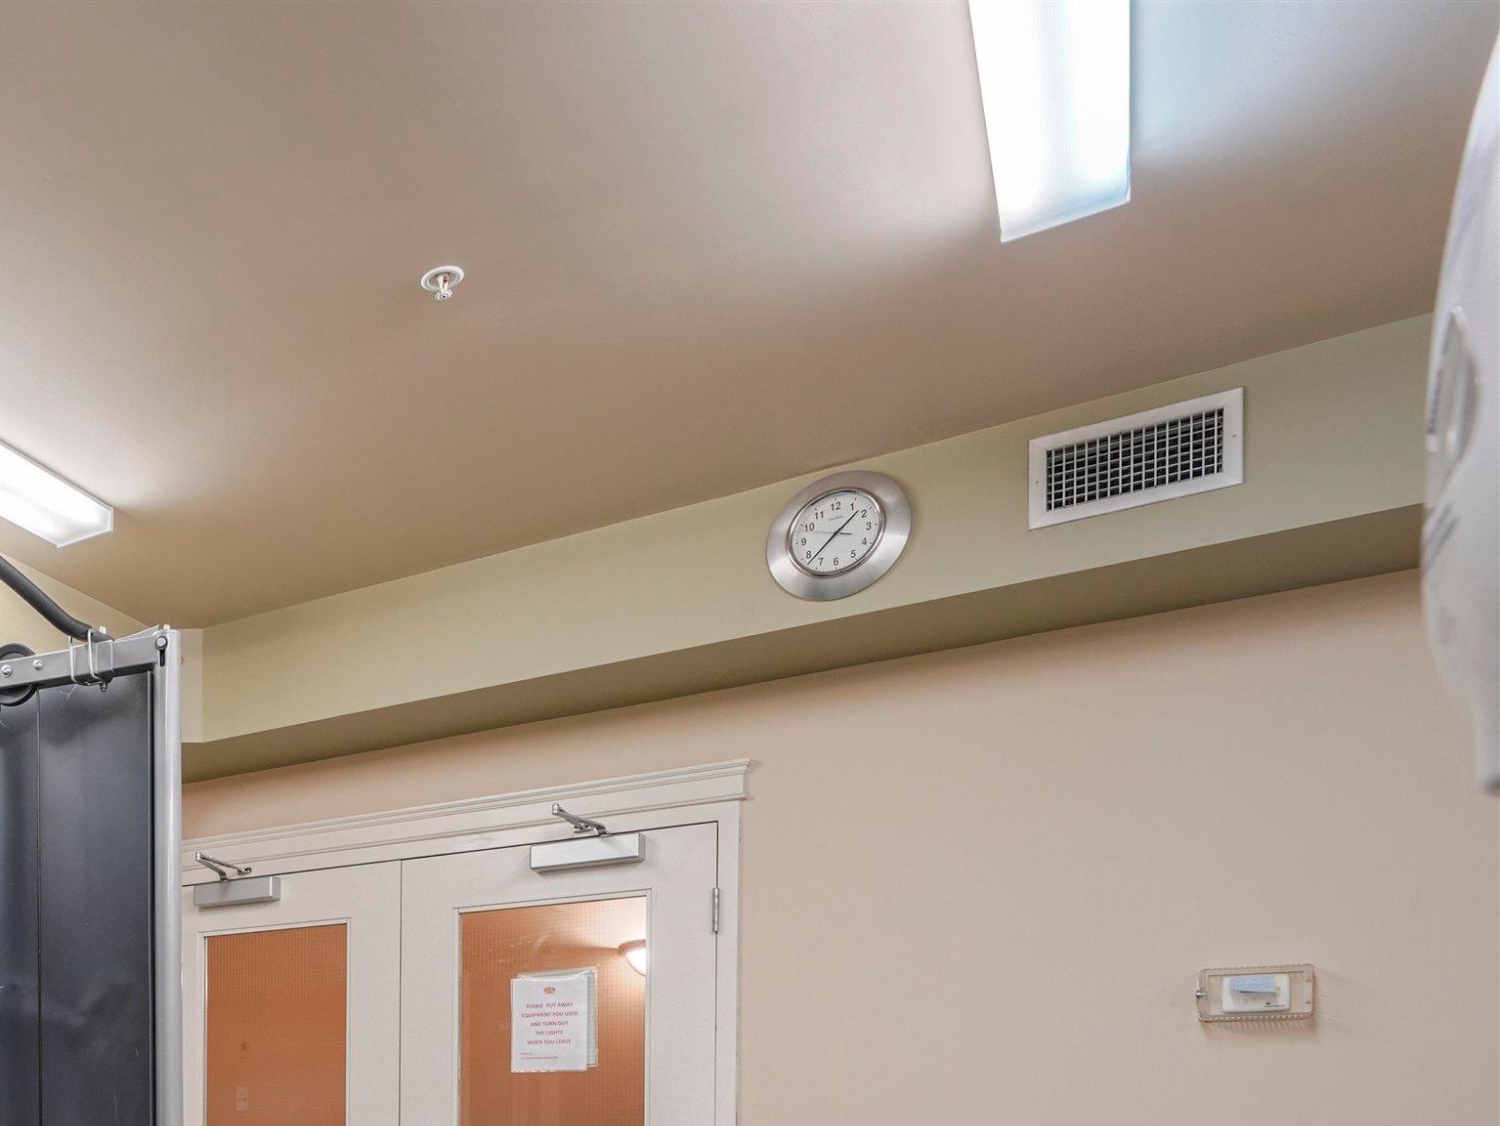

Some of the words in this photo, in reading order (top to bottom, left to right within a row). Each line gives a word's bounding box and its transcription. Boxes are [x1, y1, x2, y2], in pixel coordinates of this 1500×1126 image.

[830, 501, 842, 511] 12
[850, 503, 855, 511] 1
[814, 511, 824, 520] 11
[861, 509, 867, 518] 2
[804, 522, 815, 532] 10
[866, 522, 872, 531] 3
[800, 537, 807, 546] 9
[861, 537, 867, 546] 4
[806, 550, 812, 559] 8
[850, 550, 856, 559] 5
[818, 557, 824, 566] 7
[833, 557, 839, 566] 6
